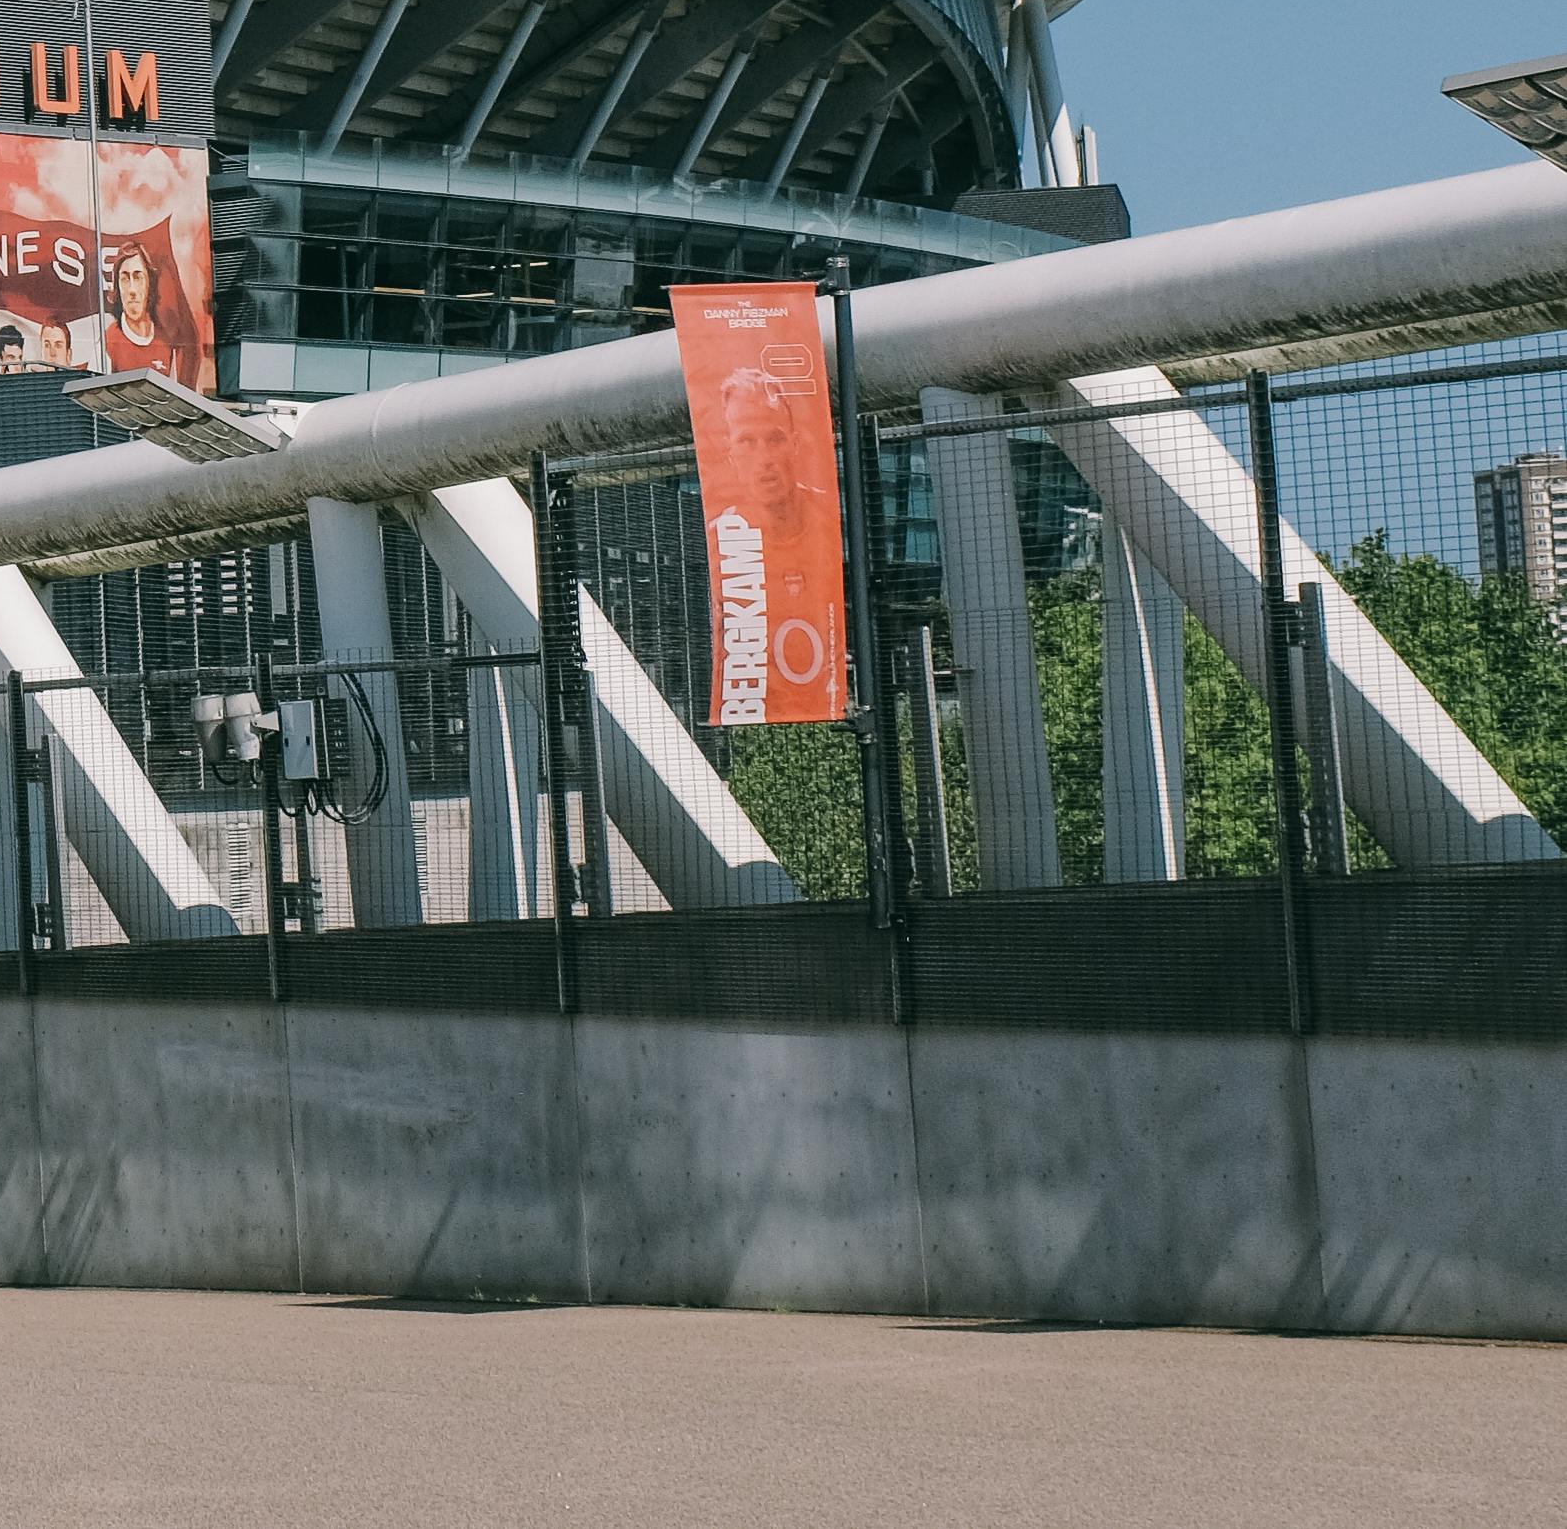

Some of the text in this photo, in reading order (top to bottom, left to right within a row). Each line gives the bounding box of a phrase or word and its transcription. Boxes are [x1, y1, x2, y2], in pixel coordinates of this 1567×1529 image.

[703, 309, 740, 319] DANNY
[729, 318, 767, 328] BRIDGE
[761, 343, 817, 402] 10
[716, 514, 768, 726] BERGKAMP
